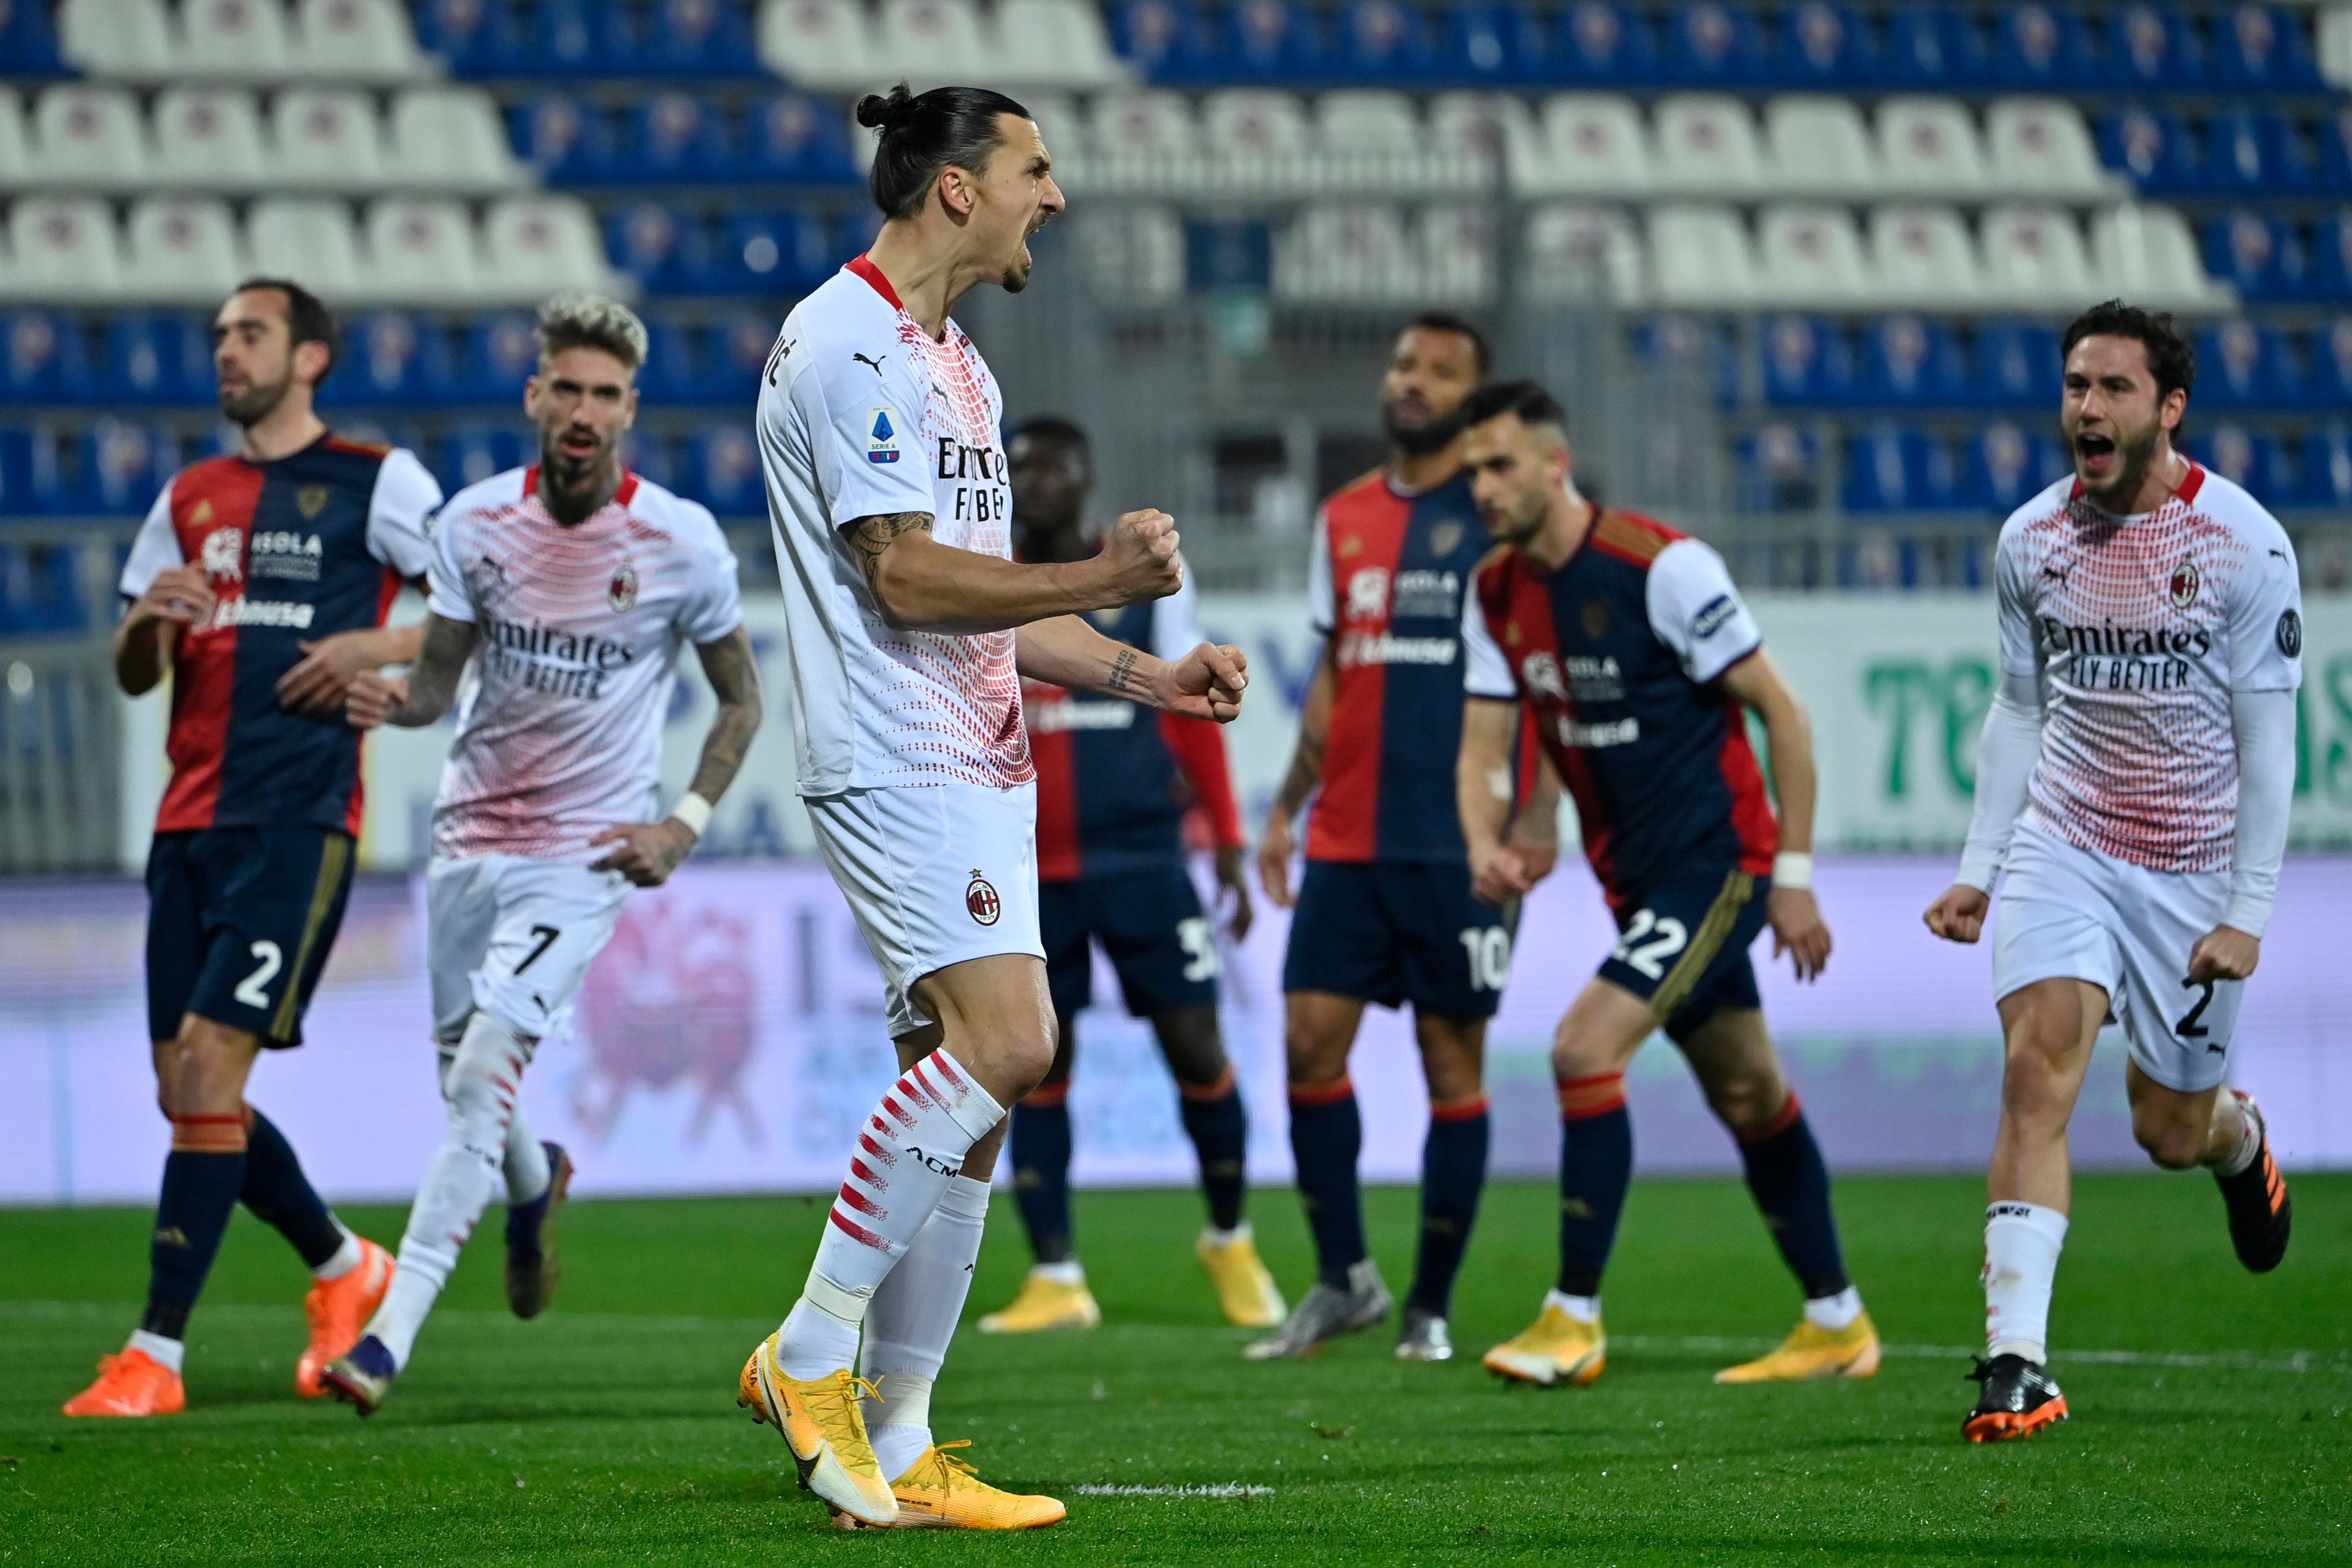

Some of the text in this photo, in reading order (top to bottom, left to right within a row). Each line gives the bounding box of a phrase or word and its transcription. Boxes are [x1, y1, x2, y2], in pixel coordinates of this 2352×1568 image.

[2044, 618, 2210, 658] Emirates
[2109, 660, 2189, 691] BETTER
[971, 883, 989, 893] ACM
[514, 923, 560, 976] 7
[1459, 925, 1510, 992] 10
[1612, 908, 1688, 981] 22
[234, 939, 283, 1009] 2
[2175, 975, 2214, 1036] 2
[905, 1147, 959, 1178] ACM
